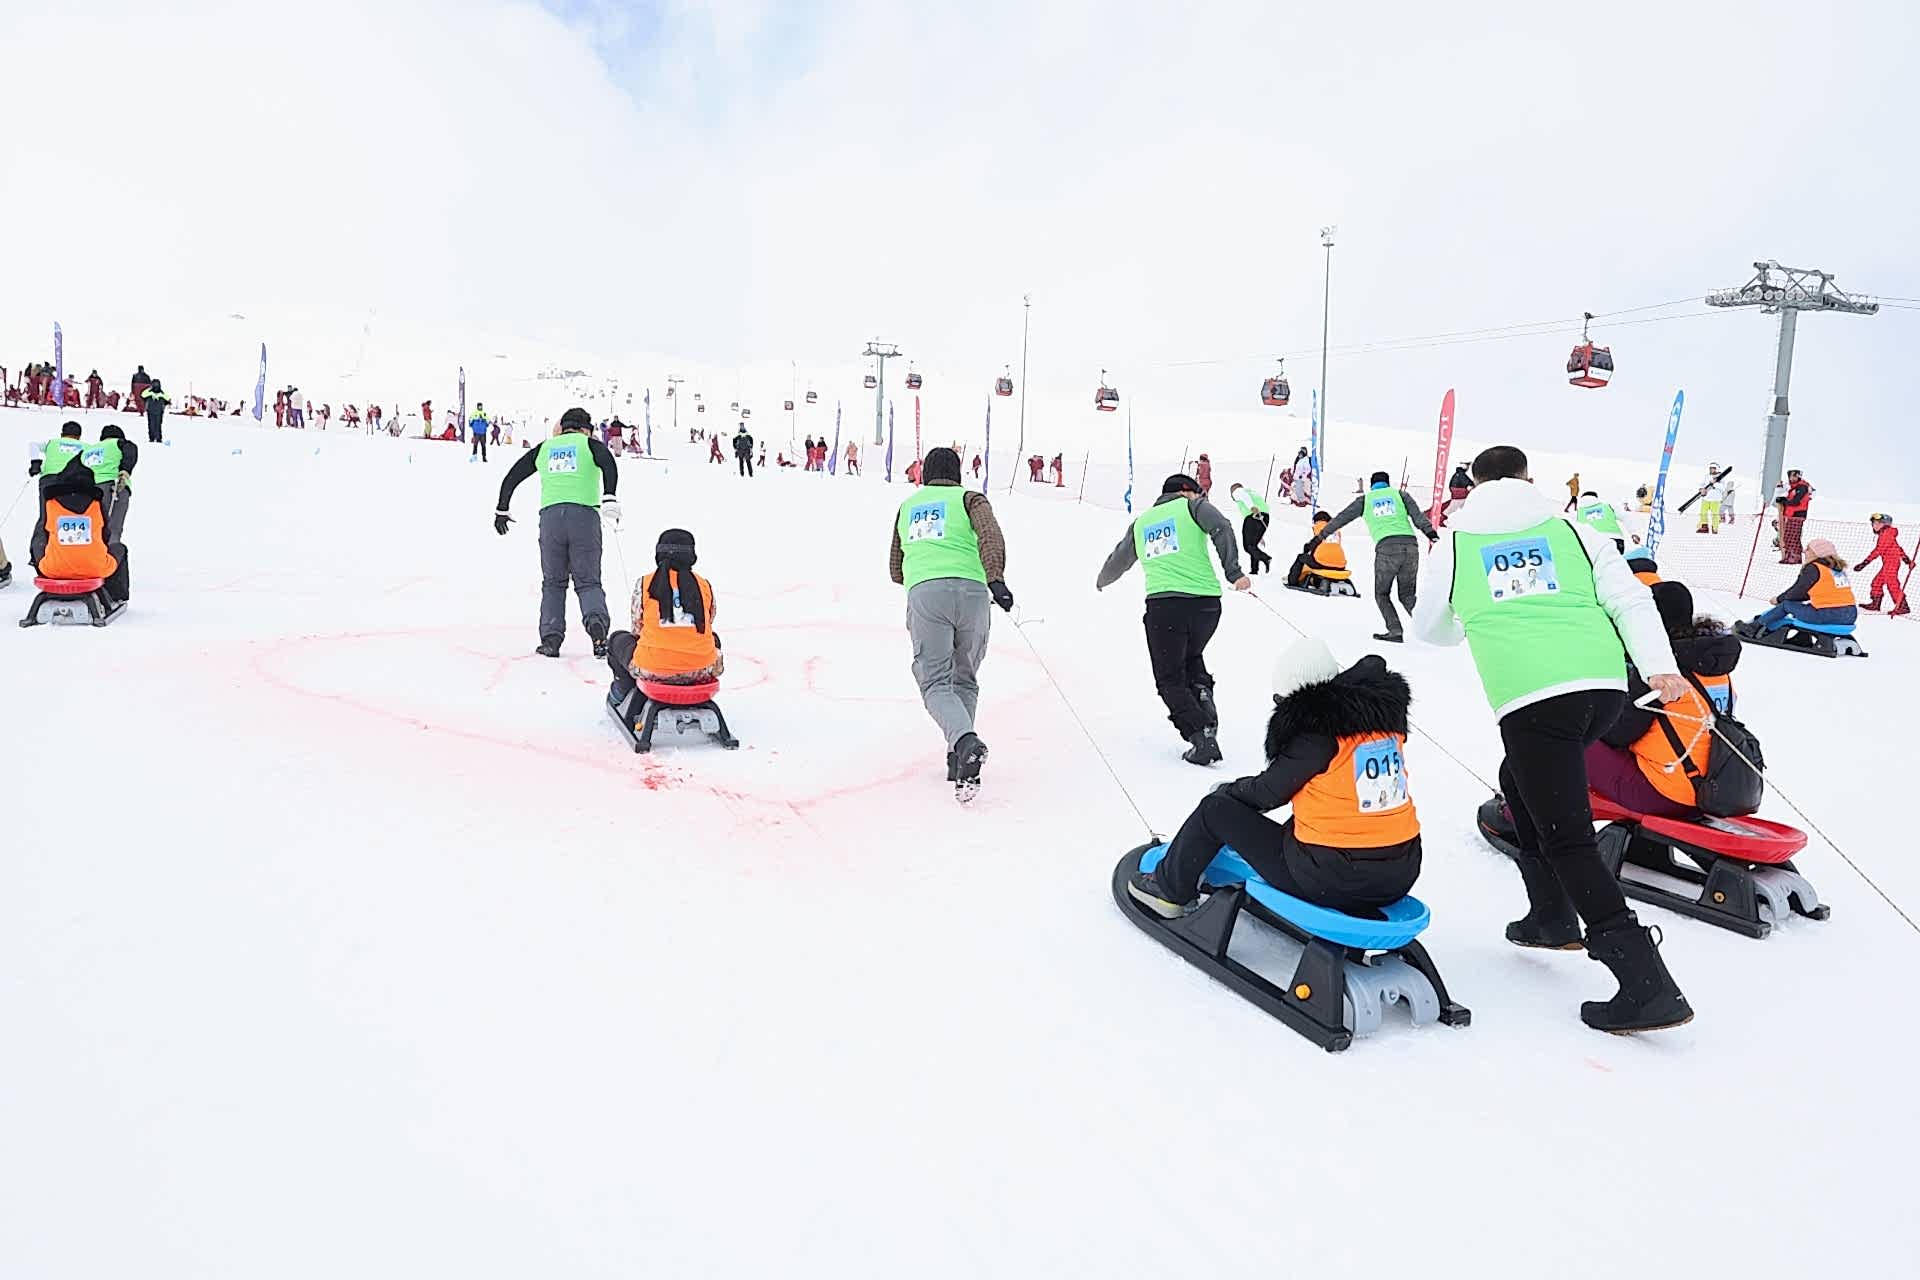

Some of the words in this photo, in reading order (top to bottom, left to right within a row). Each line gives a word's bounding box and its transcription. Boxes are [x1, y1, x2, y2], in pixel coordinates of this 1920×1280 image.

[914, 509, 940, 524] 015
[62, 522, 86, 532] 014
[1148, 526, 1171, 543] 020
[1494, 548, 1543, 572] 035
[1365, 751, 1400, 780] 015
